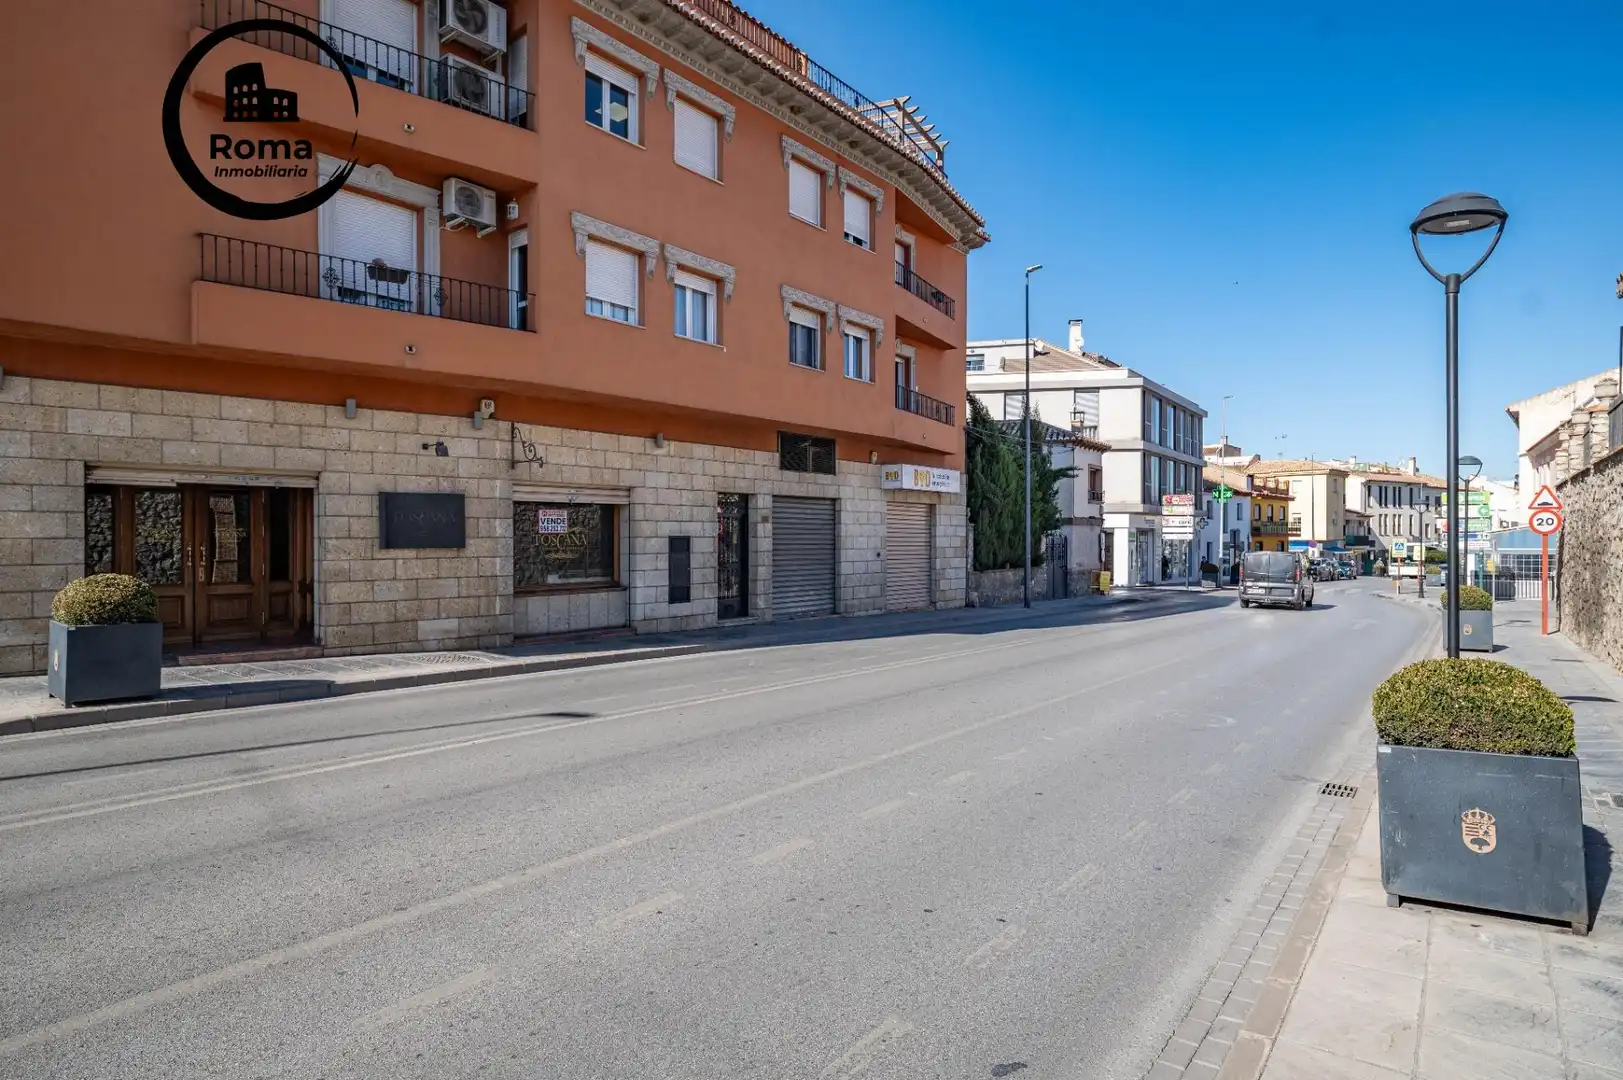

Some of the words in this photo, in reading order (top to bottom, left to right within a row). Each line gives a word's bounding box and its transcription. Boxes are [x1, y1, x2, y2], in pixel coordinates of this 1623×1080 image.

[540, 517, 566, 525] VENDE
[1536, 517, 1554, 526] 20
[532, 534, 588, 549] TOSCANA
